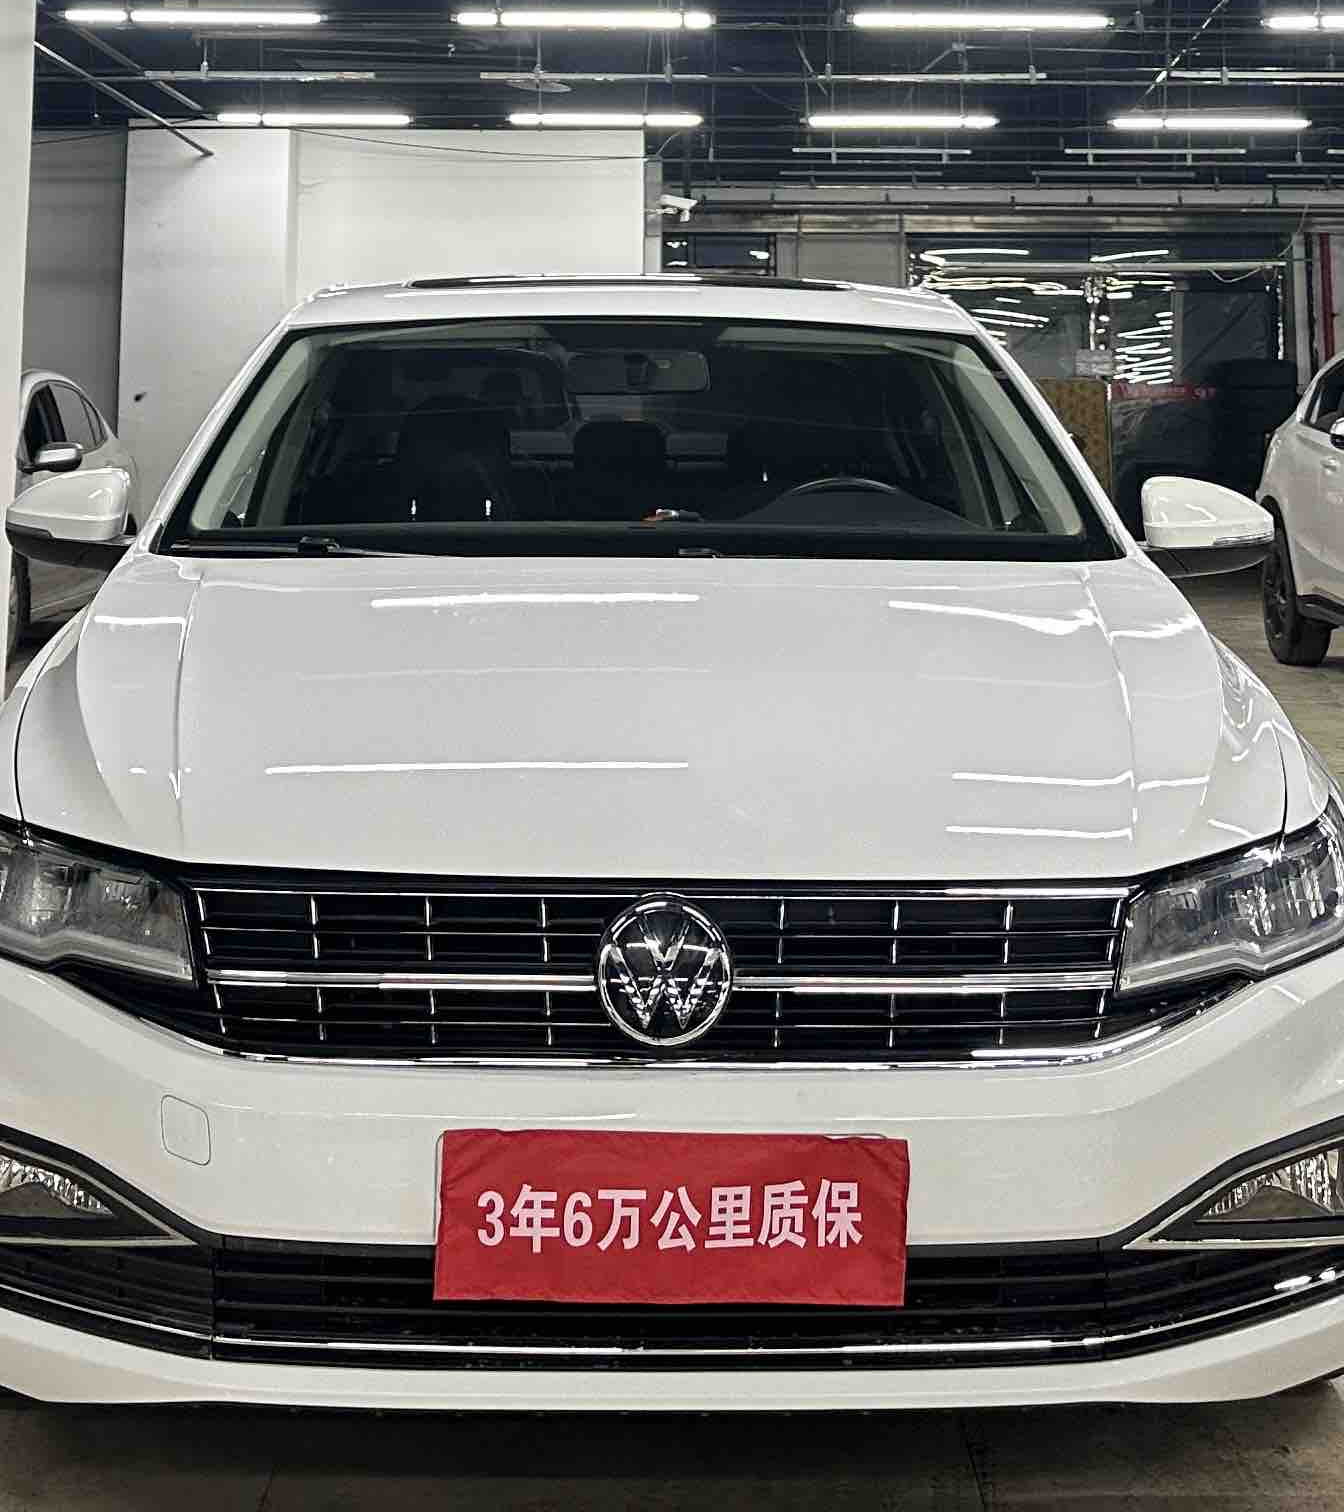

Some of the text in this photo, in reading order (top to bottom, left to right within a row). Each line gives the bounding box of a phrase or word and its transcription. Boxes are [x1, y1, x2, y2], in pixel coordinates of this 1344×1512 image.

[477, 1178, 863, 1253] 3年6万公里质保
